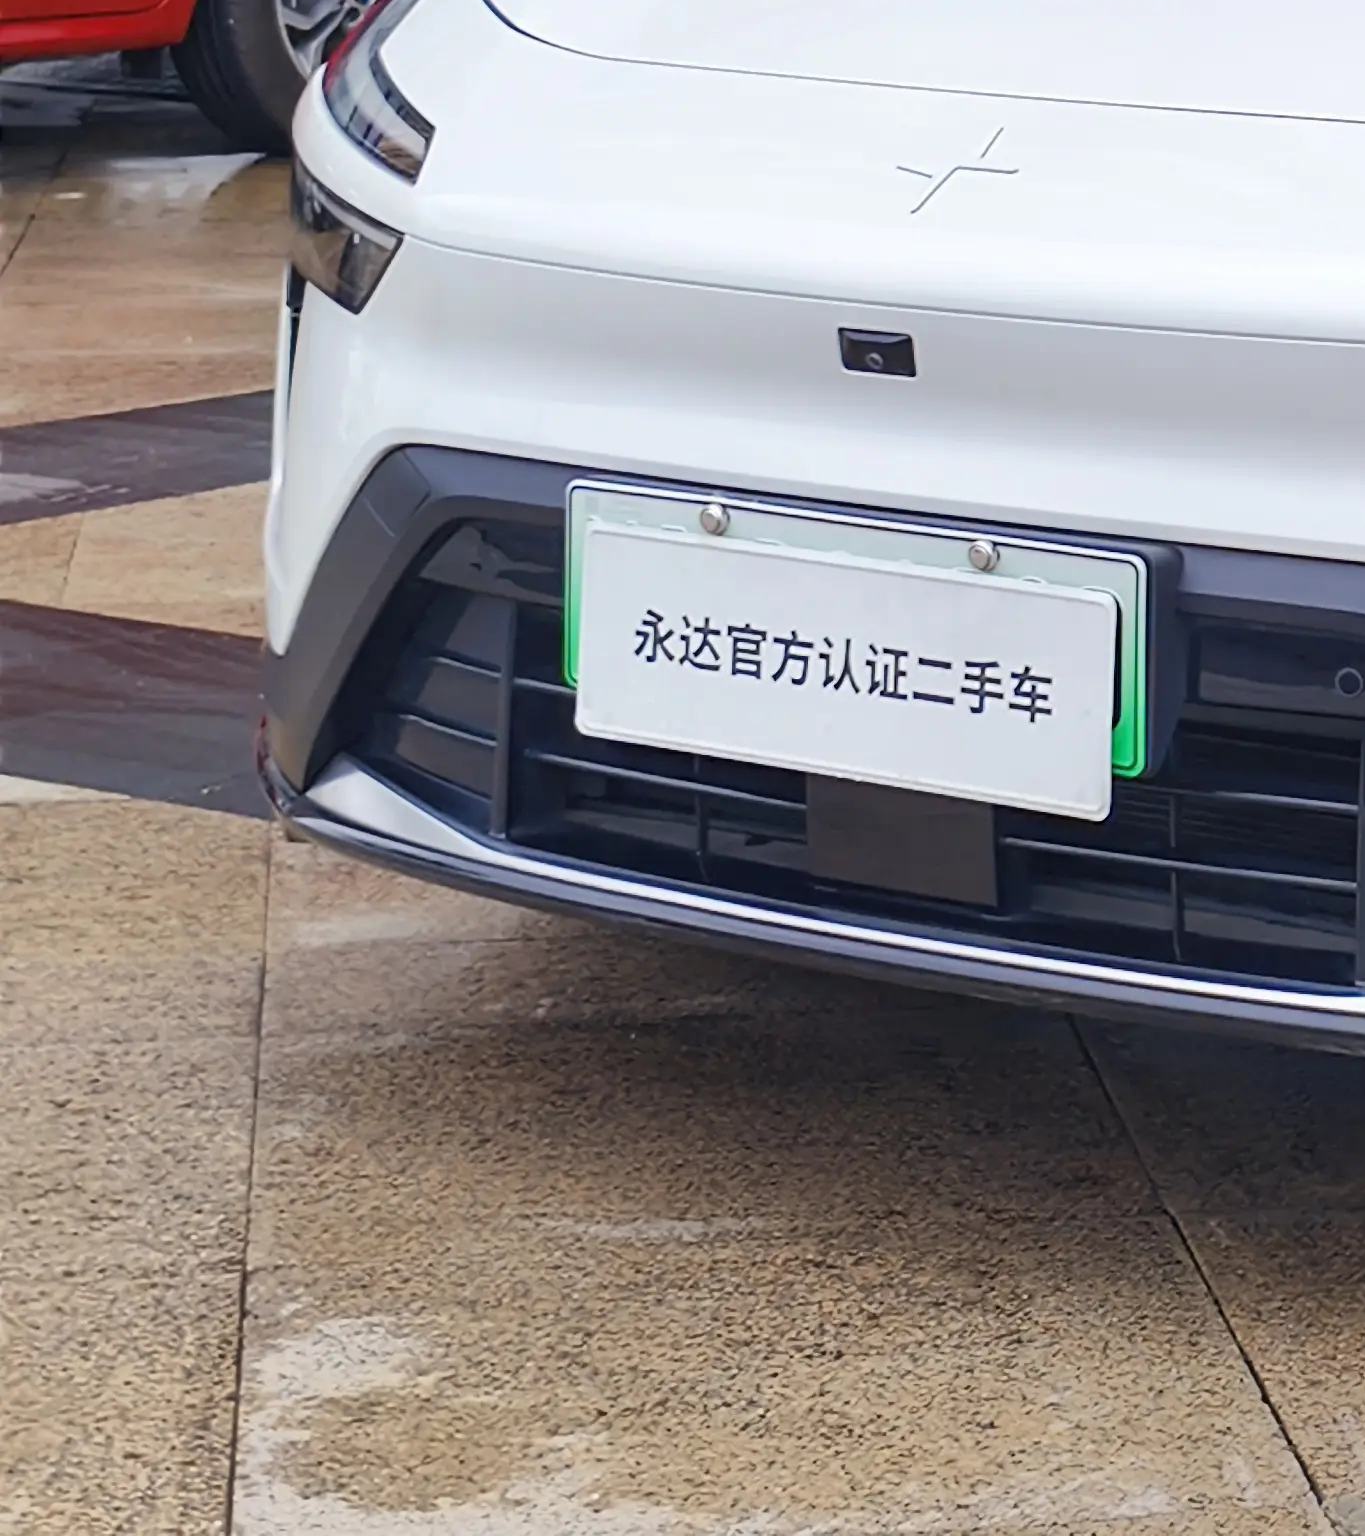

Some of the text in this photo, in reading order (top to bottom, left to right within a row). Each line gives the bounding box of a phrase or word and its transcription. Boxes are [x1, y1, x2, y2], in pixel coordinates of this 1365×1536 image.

[634, 608, 1054, 724] 永达官方认证二手车
